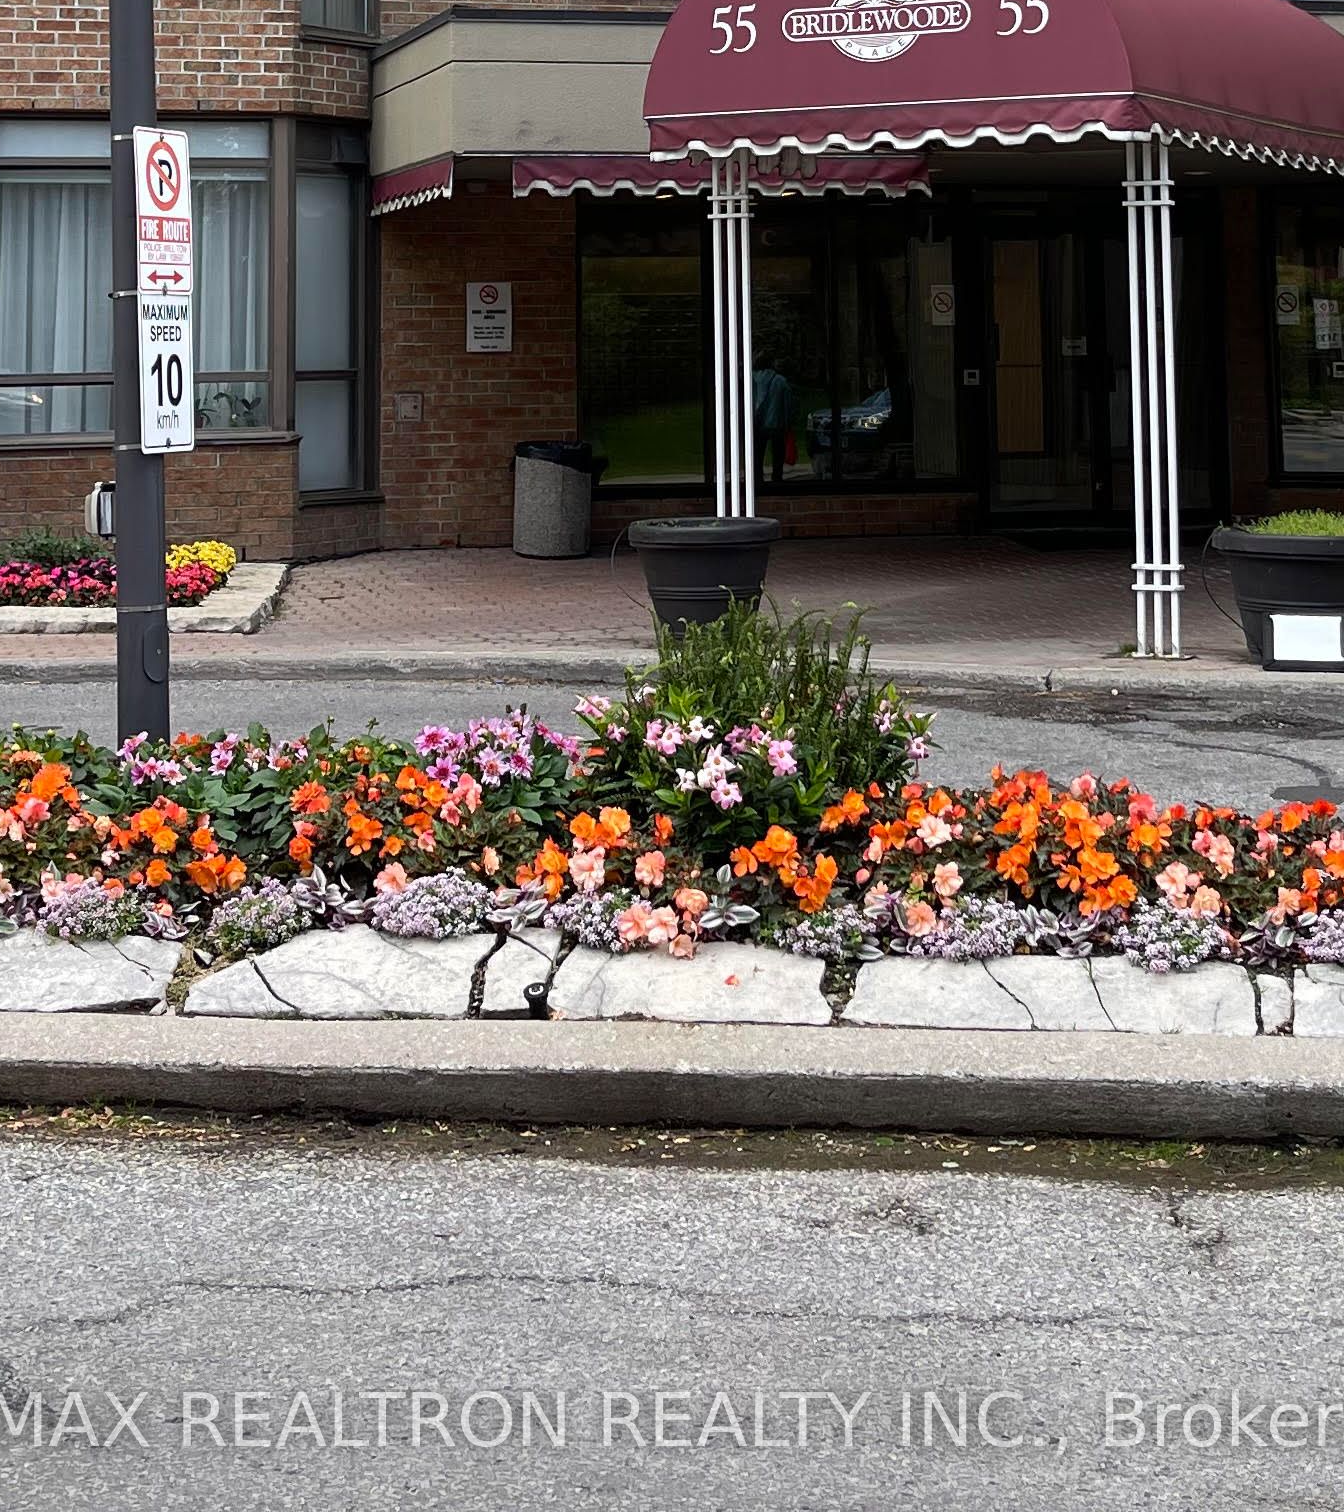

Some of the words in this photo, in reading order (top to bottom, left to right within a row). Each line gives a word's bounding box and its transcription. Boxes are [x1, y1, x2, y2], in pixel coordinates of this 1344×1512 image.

[709, 3, 758, 55] 55
[789, 3, 962, 38] BRIDLEWOODE
[844, 38, 907, 58] PLACE
[141, 218, 160, 240] FIRE
[162, 219, 189, 242] ROUTE
[142, 304, 188, 321] MAXIMUM
[150, 325, 182, 342] SPEED
[151, 353, 183, 407] 10
[157, 409, 180, 430] km/h
